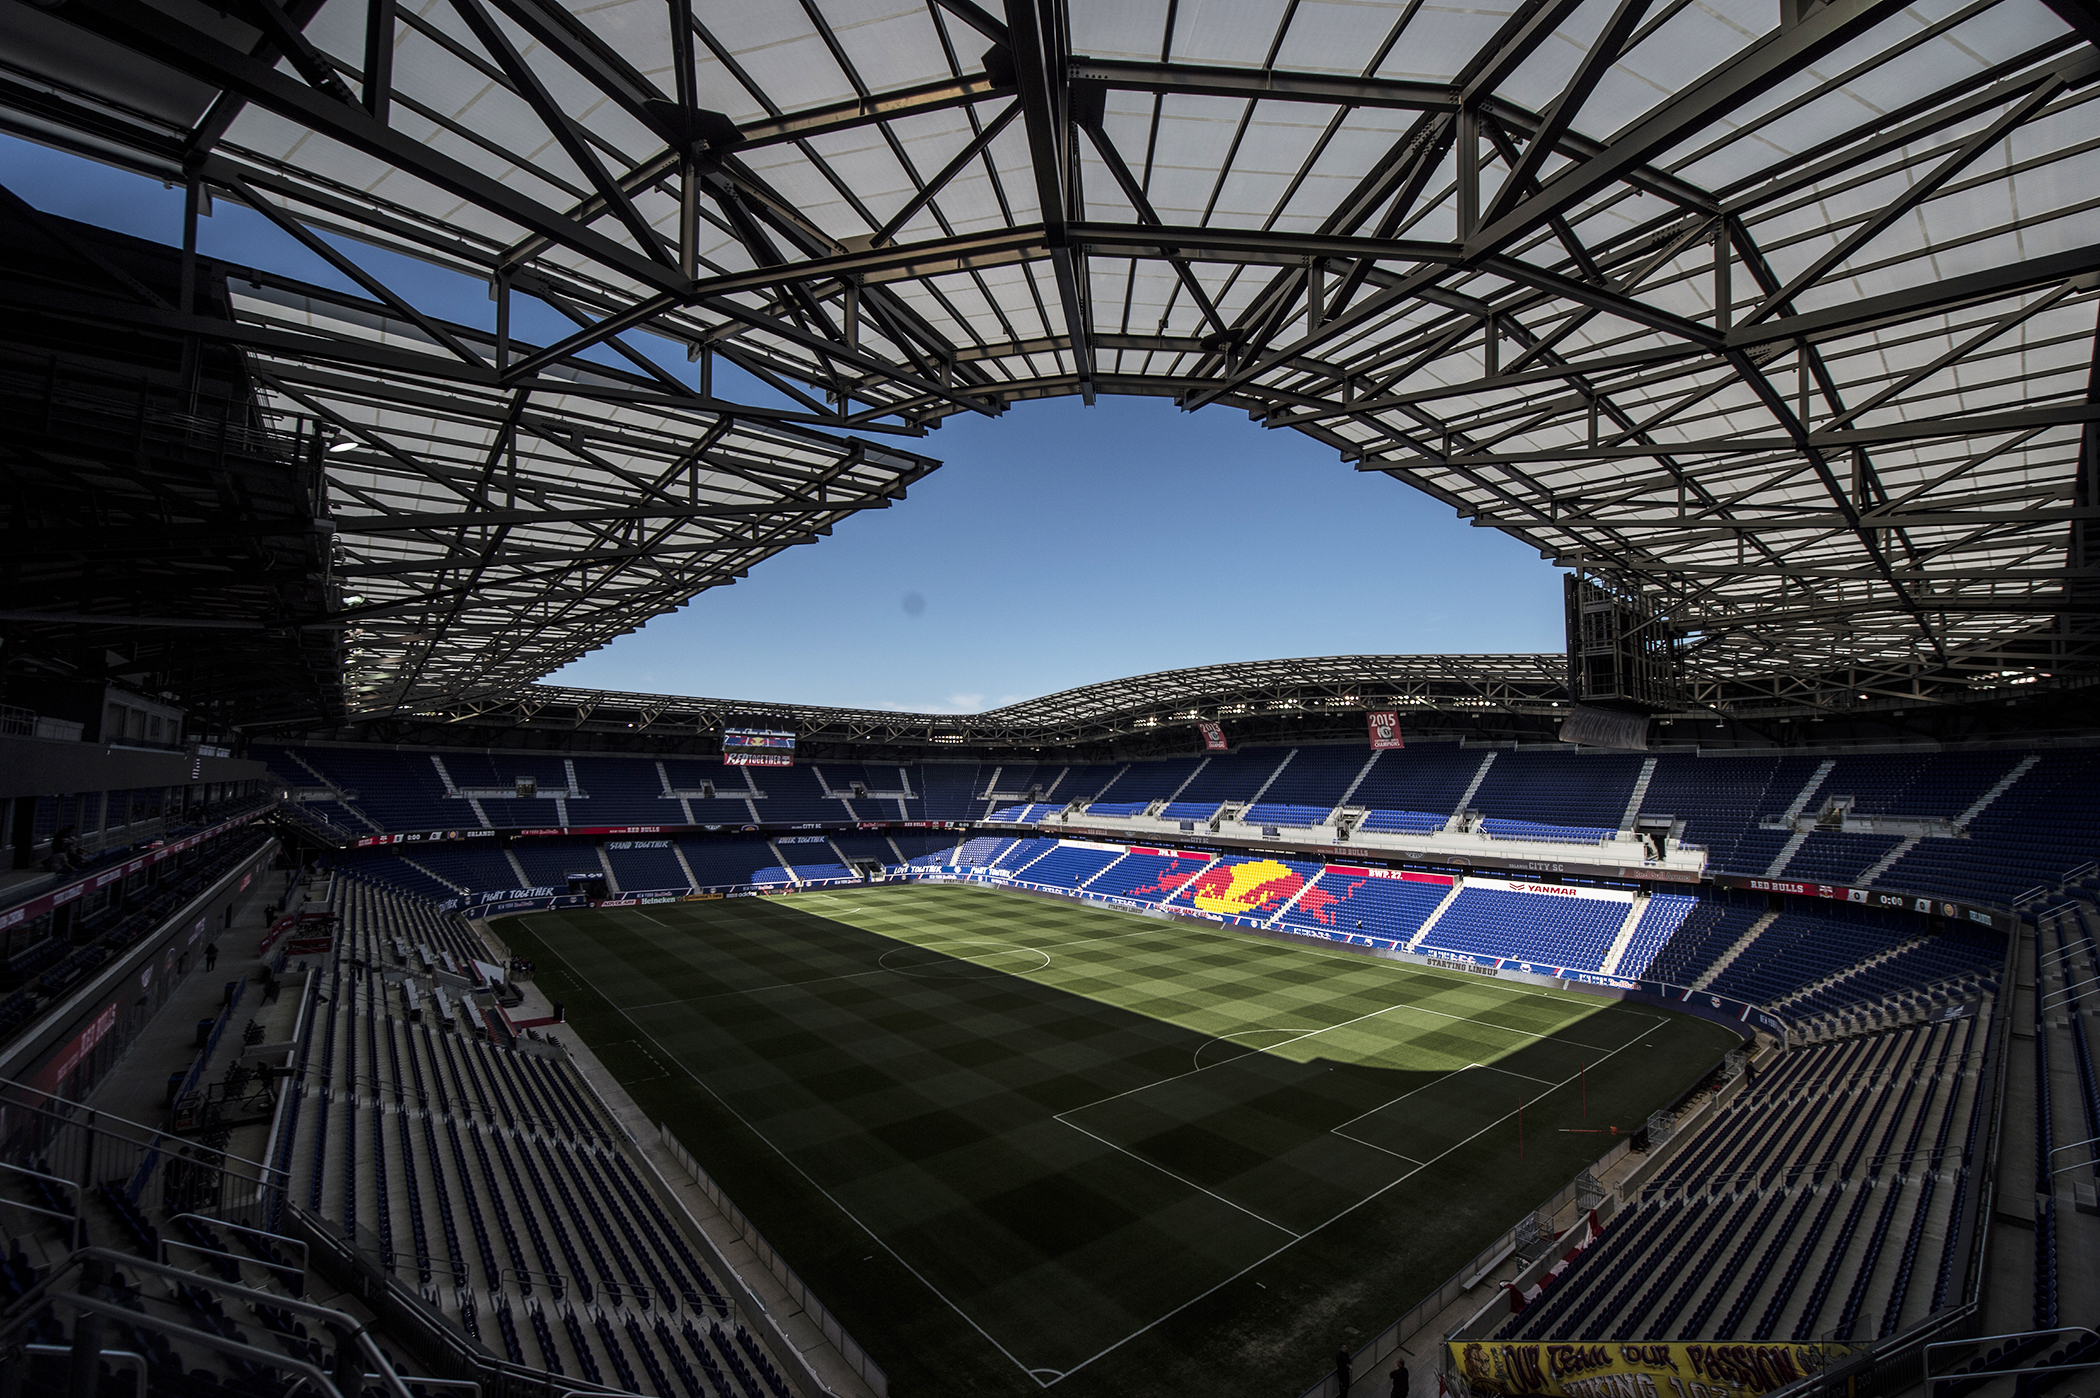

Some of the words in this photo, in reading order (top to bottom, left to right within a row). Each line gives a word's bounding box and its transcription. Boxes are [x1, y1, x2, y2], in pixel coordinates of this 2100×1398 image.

[1369, 713, 1396, 727] 2015
[1200, 723, 1220, 733] 2013
[609, 842, 631, 850] STAND
[634, 841, 669, 849] TOGETHER
[1348, 849, 1368, 857] BULLS
[894, 866, 908, 874] LOVE
[1528, 861, 1550, 871] CITY
[1552, 863, 1564, 871] SC
[1528, 885, 1577, 896] YANMAR
[1750, 880, 1770, 889] RED
[1771, 882, 1804, 893] BULLS
[480, 890, 506, 905] FIGHT
[509, 886, 554, 899] TOGETHER
[641, 896, 676, 905] Heineken
[1853, 892, 1860, 900] 0
[1880, 894, 1903, 906] 0:00
[1920, 901, 1925, 910] 0
[1427, 958, 1466, 972] STARTING
[1468, 964, 1498, 976] LINEUP
[1505, 1344, 1548, 1393] OUR
[1548, 1345, 1613, 1377] TEAM
[1625, 1345, 1678, 1373] OUR
[1687, 1345, 1799, 1393] PASSION
[1857, 1372, 1872, 1389] 203
